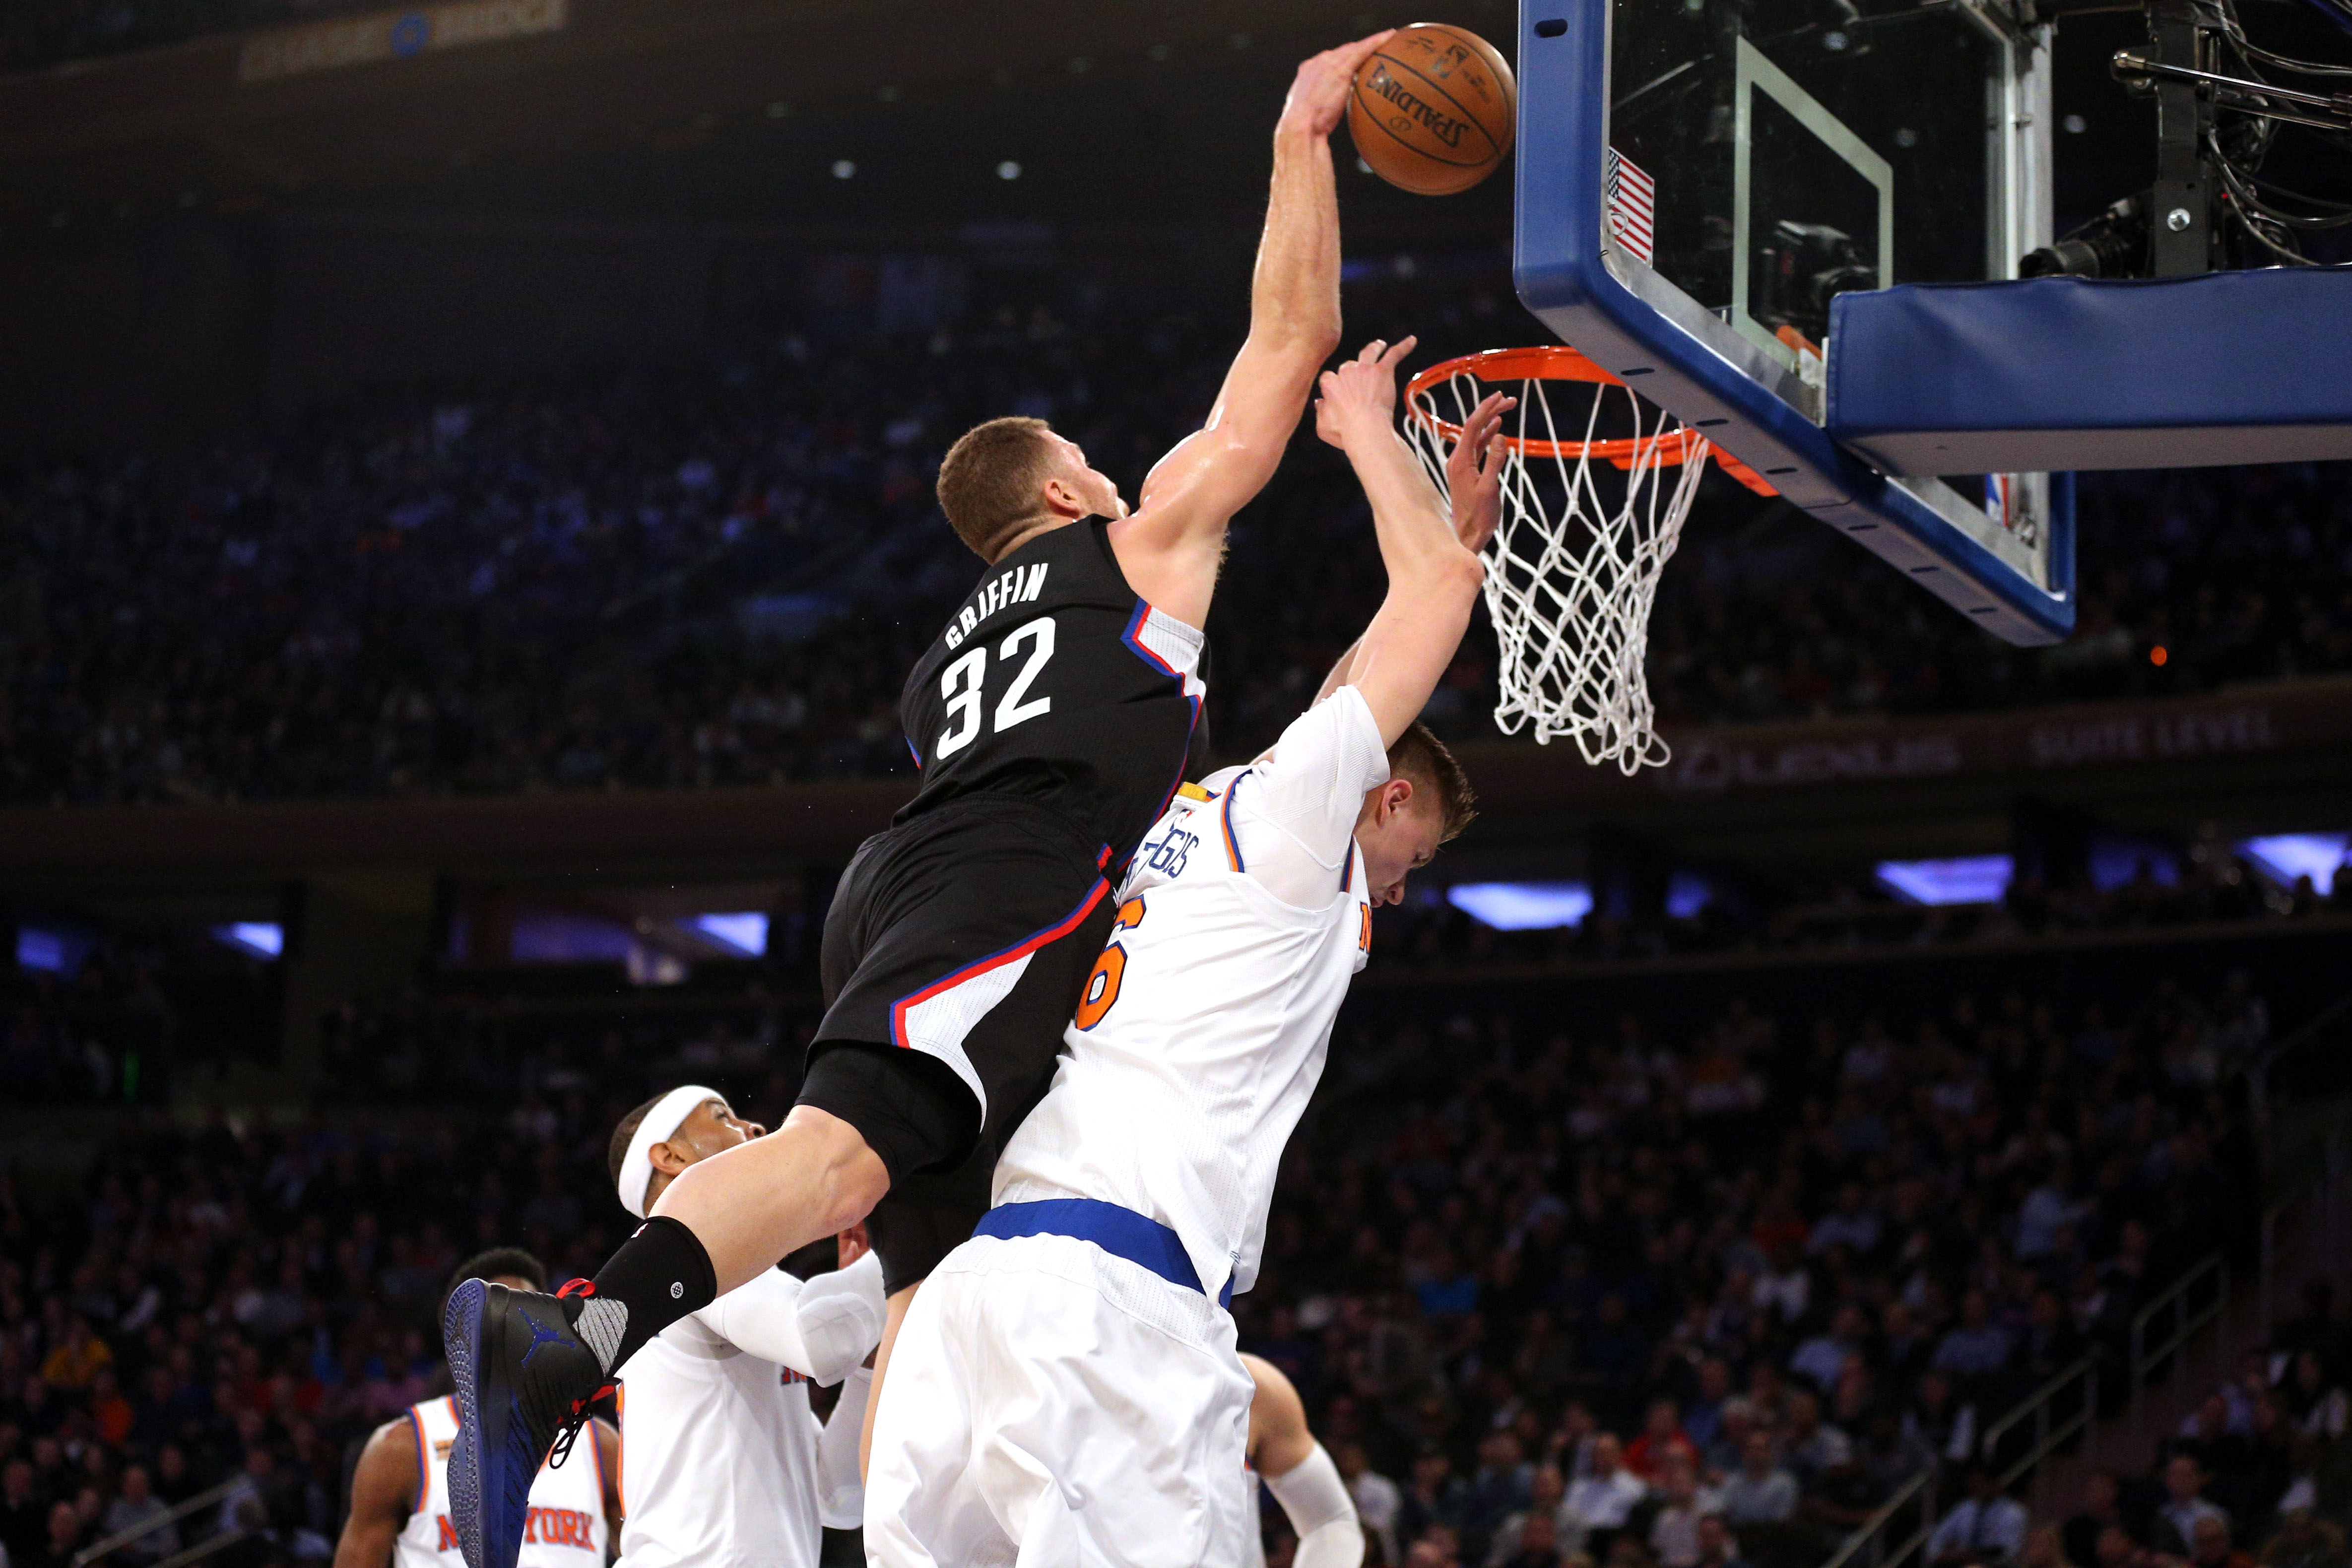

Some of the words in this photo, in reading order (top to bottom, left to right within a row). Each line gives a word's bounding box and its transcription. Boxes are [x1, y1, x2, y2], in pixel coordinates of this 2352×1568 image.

[1366, 61, 1470, 148] SPALDING
[944, 562, 1049, 651] GRIFFIN
[936, 616, 1056, 761] 32
[1739, 738, 1961, 785] LEXUS
[2030, 722, 2144, 768] SUITE
[2156, 710, 2278, 755] LEVEL
[1076, 893, 1147, 1032] 6
[524, 1506, 596, 1552] YORK
